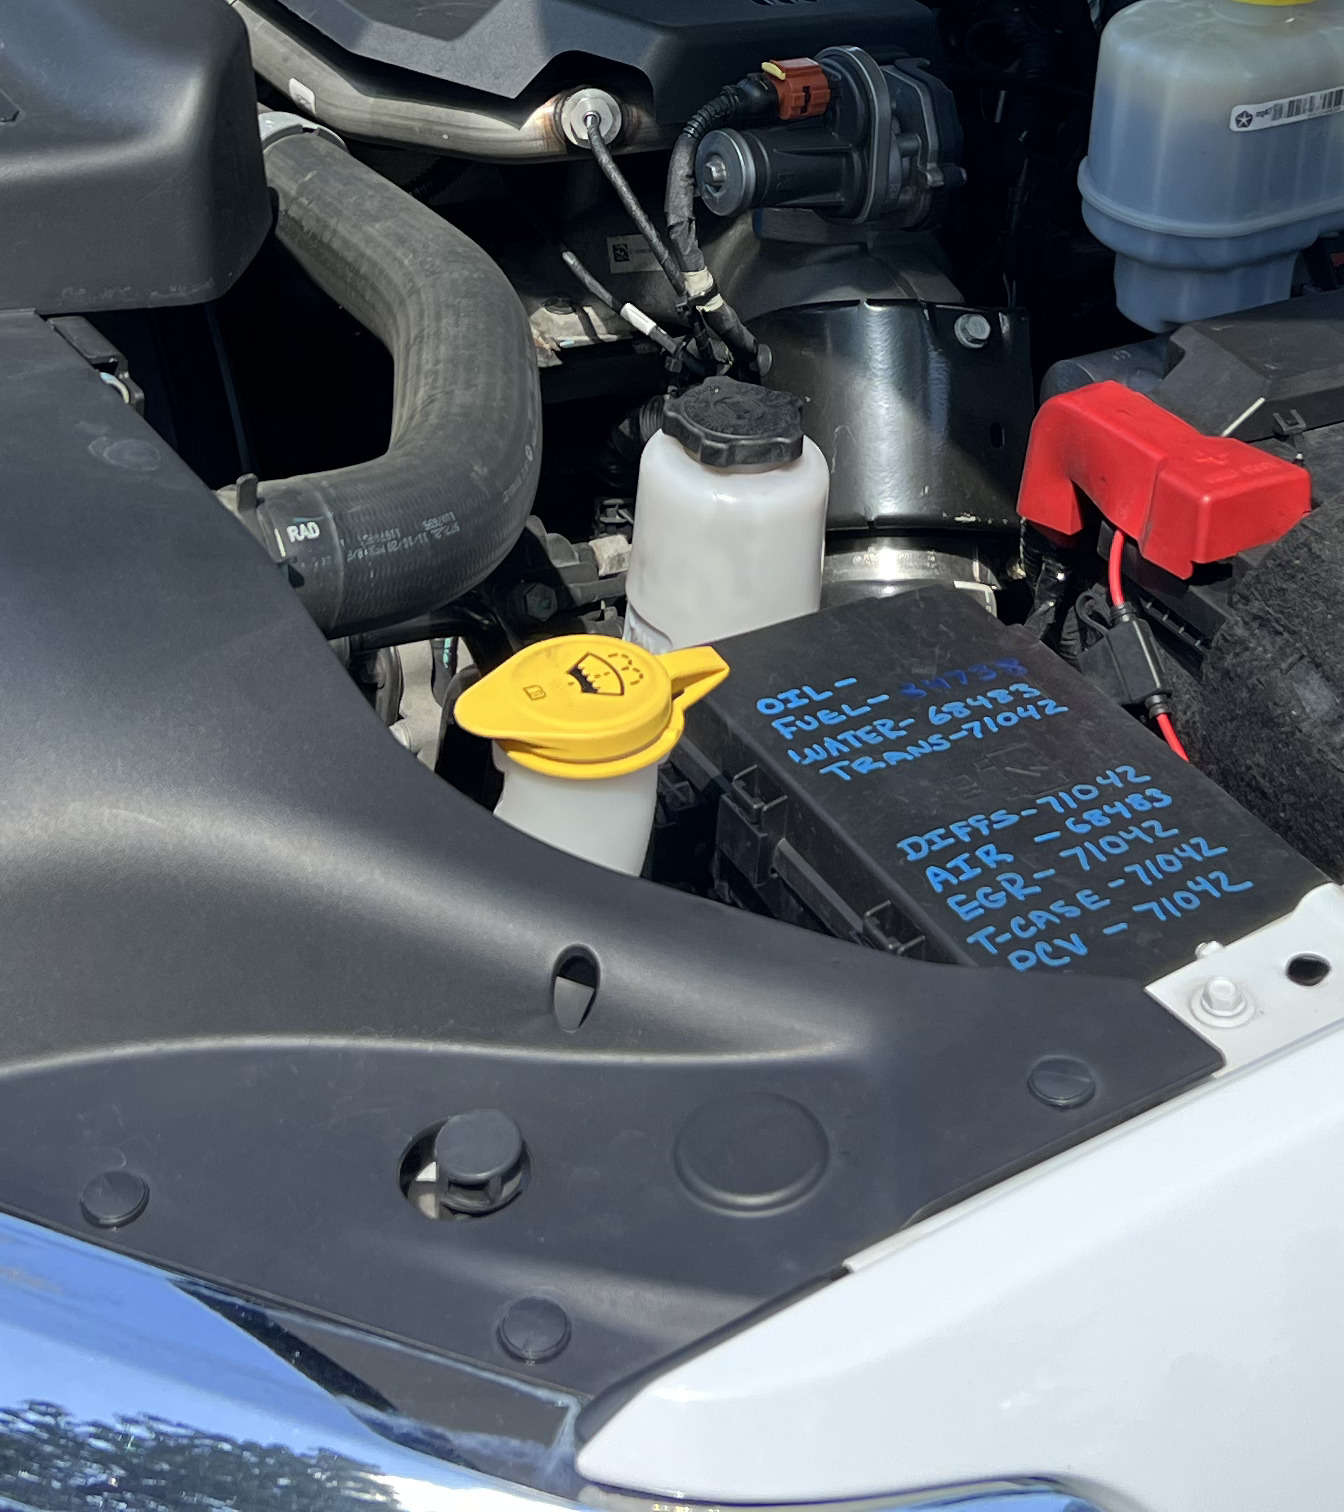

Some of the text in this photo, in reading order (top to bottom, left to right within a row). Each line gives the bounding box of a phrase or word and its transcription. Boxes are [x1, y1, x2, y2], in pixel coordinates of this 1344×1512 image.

[286, 521, 320, 543] RAD
[928, 683, 1041, 725] 68483
[925, 843, 1014, 893] AIR
[1059, 820, 1179, 871] 71042
[1132, 870, 1254, 921] 71042
